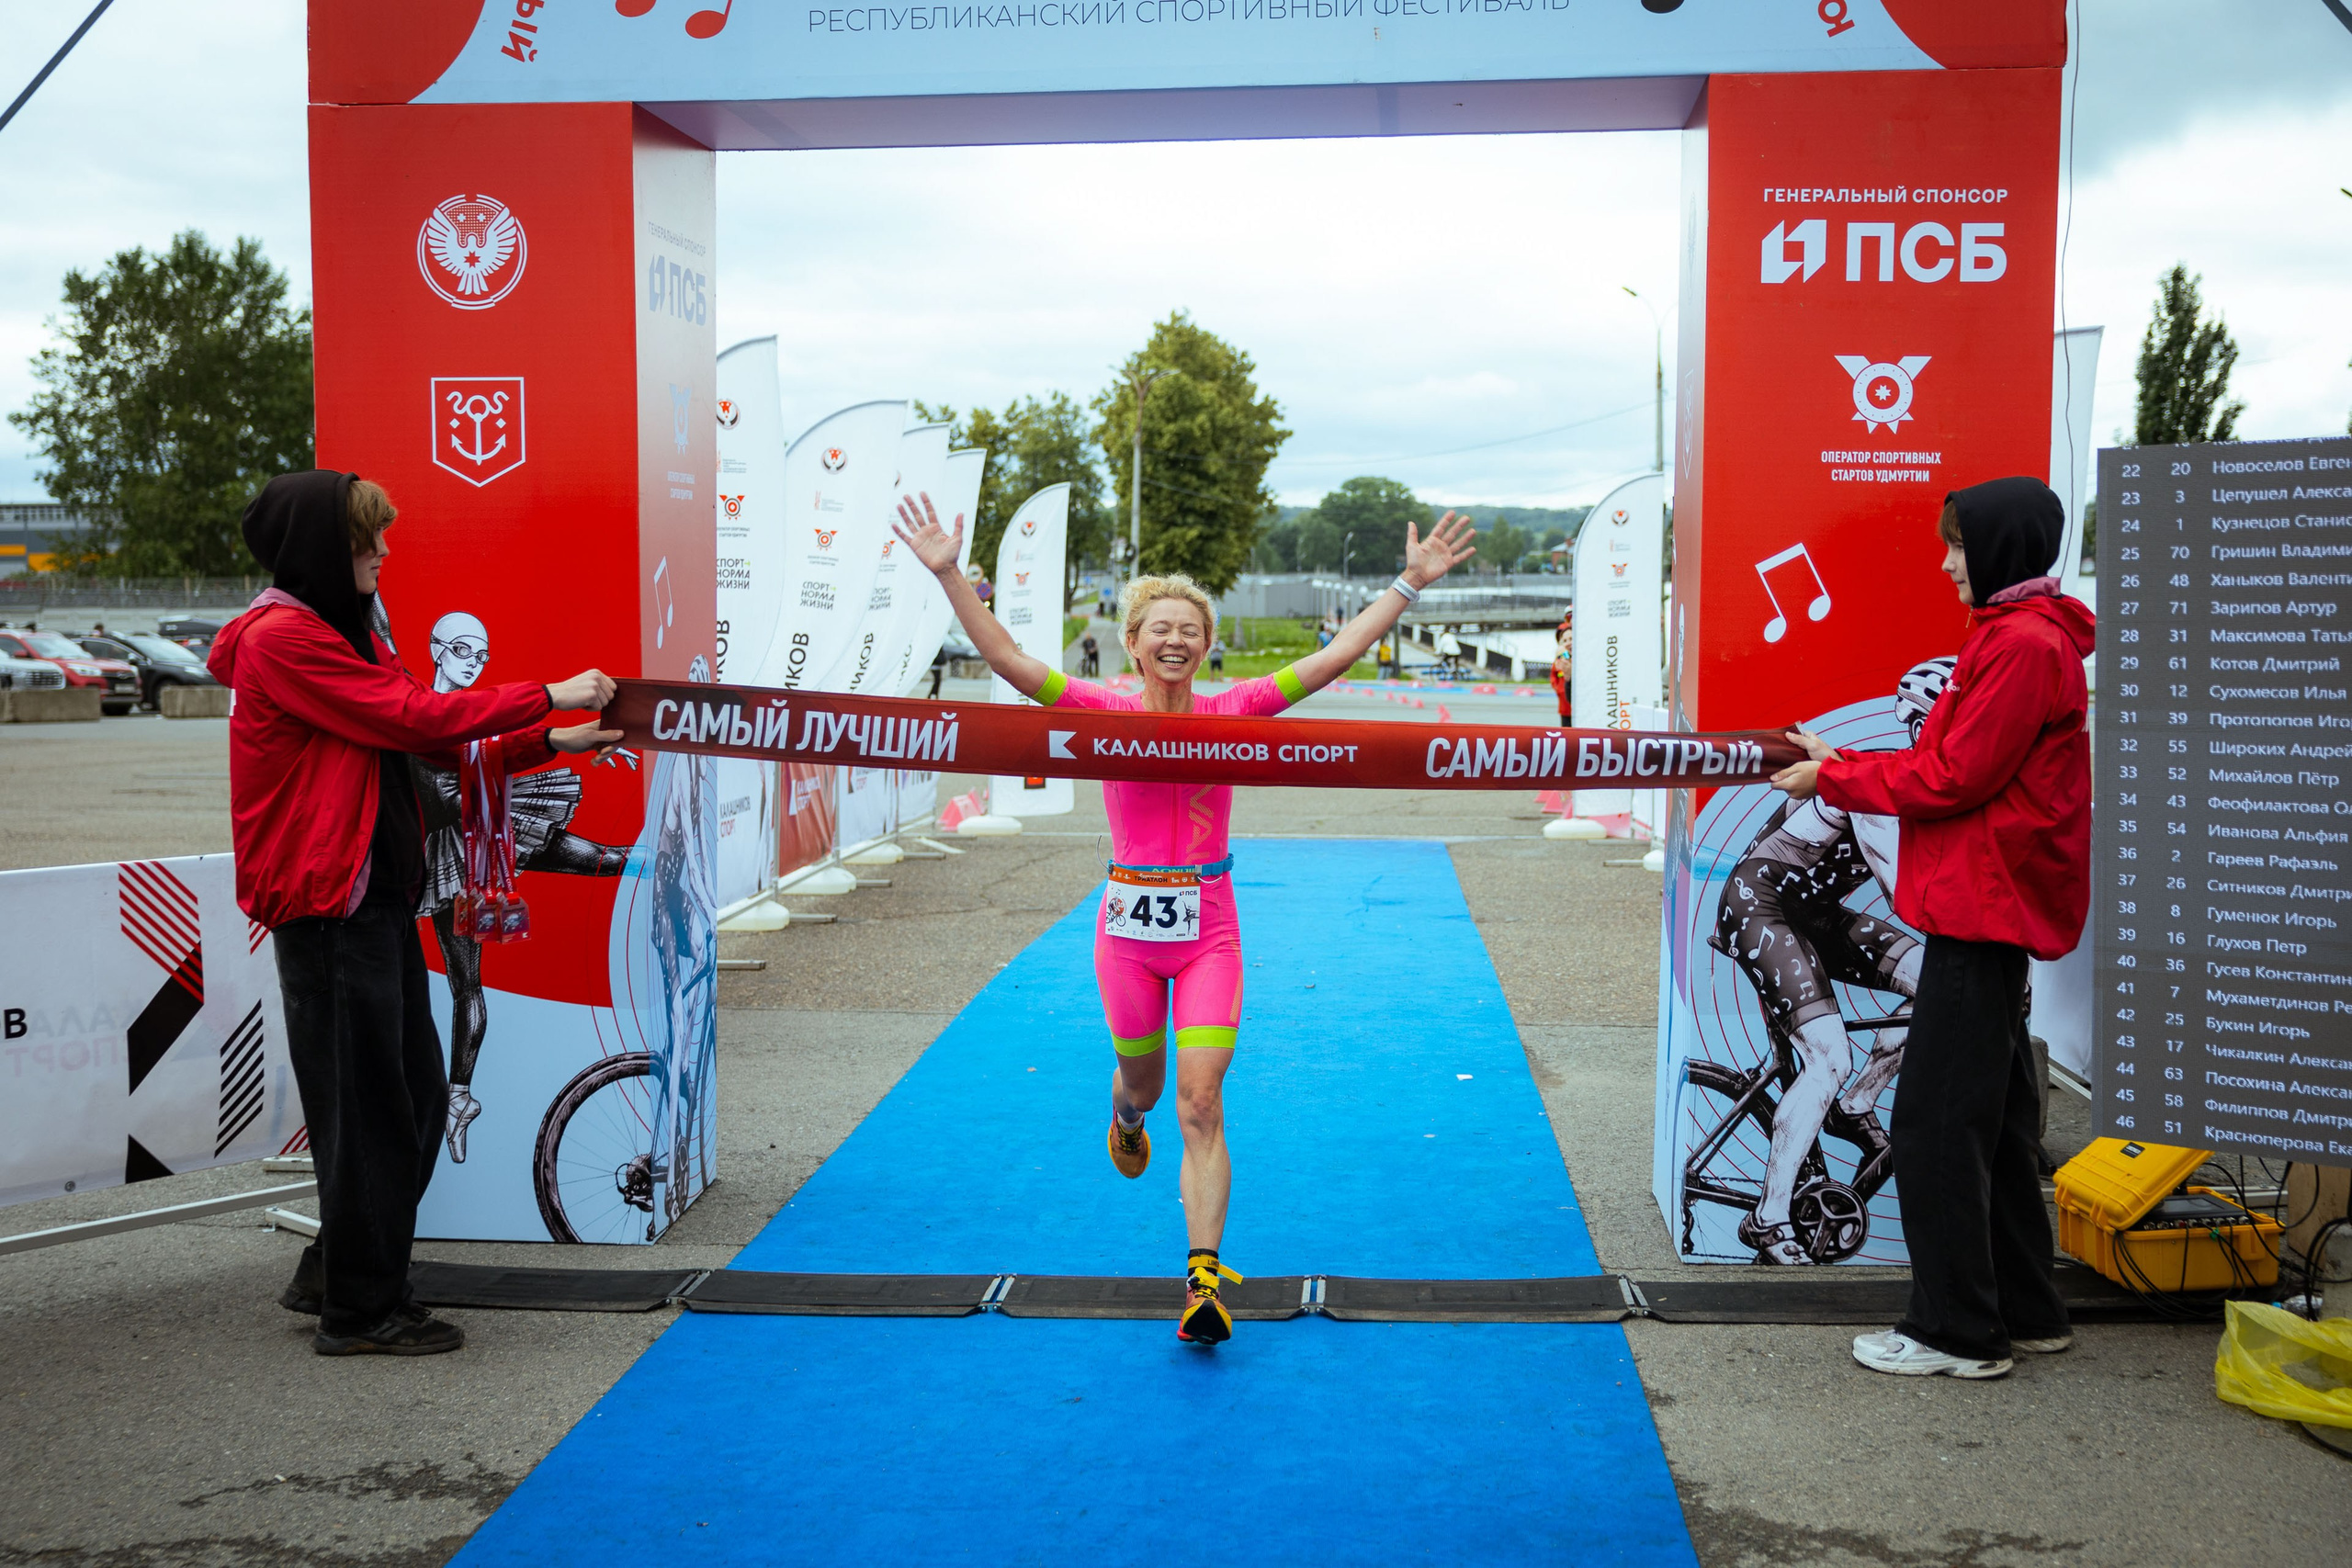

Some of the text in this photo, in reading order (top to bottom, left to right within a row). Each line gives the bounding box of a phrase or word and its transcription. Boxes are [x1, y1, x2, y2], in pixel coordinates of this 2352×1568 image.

[809, 0, 1125, 32] РЕСПУБЛИКАНСКИЙ
[1136, 0, 1363, 23] СПОРТИВНЫЙ
[1763, 186, 2008, 203] ГЕНЕРАЛЬНЫЙ СПОНСОР
[1846, 220, 2007, 283] ПСБ
[669, 261, 707, 326] ПСБ
[1821, 450, 1941, 465] ОПЕРАТОР СПОРТИВНЫХ
[2122, 464, 2142, 478] 22
[2171, 461, 2192, 476] 20
[2213, 459, 2306, 474] Новоселов
[1831, 468, 1929, 482] СТАРТОВ УДМУРТИИ
[2121, 491, 2142, 505] 23
[2176, 490, 2187, 503] 3
[2212, 489, 2290, 504] Цепушел
[2121, 519, 2142, 533] 24
[2177, 517, 2184, 531] 1
[2212, 516, 2291, 534] Кузнецов
[2120, 547, 2142, 560] 25
[2170, 546, 2191, 559] 70
[2211, 545, 2278, 561] Гришин
[802, 581, 831, 592] СПОРТ
[2121, 574, 2142, 588] 26
[2169, 573, 2191, 587] 48
[2211, 573, 2285, 587] Ханыков
[799, 599, 834, 611] ЖИЗНИ
[800, 590, 835, 602] НОРМА
[2120, 600, 2339, 617] 27 71 Зарипов Артур
[2120, 628, 2141, 643] 28
[2169, 628, 2188, 643] 31
[2211, 628, 2307, 643] Максимова
[2120, 656, 2341, 674] 29 61 Котов Дмитрий
[2120, 683, 2348, 702] 30 12 Сухомесов Илья
[652, 698, 960, 761] САМЫЙ ЛУЧШИЙ
[2120, 710, 2352, 729] 31 39 Протопопов Иго
[1092, 738, 1359, 762] КАЛАШНИКОВ СПОРТ
[1426, 731, 1763, 778] САМЫЙ БЫСТРЫЙ
[2120, 738, 2139, 752] 32
[2169, 739, 2188, 753] 55
[2210, 740, 2287, 758] Широких
[2120, 765, 2341, 789] 33 52 Михайлов Пётр
[2119, 792, 2352, 815] 34 43 Феофилактова О
[2119, 819, 2350, 845] 35 54 Иванова Альфия
[2119, 846, 2340, 873] 36 2 Гареев Рафаэль
[2118, 874, 2138, 886] 37
[2166, 876, 2188, 890] 26
[2208, 879, 2288, 897] Ситников
[1129, 895, 1179, 929] 43
[2119, 900, 2338, 931] 38 8 Гуменюк Игорь
[2118, 927, 2309, 957] 39 16 Глухов Петр
[2117, 954, 2352, 987] 40 36 Гусев Константин
[2117, 981, 2135, 995] 41
[2170, 986, 2182, 998] 7
[2206, 988, 2331, 1012] Мухаметдинов
[2117, 1008, 2312, 1041] 42 25 Букин Игорь
[2117, 1034, 2136, 1048] 43
[2165, 1039, 2186, 1053] 17
[2206, 1043, 2286, 1064] Чикалкин
[2116, 1061, 2136, 1076] 44
[2165, 1066, 2185, 1081] 63
[2206, 1070, 2286, 1093] Посохина
[2116, 1088, 2136, 1102] 45
[2165, 1093, 2186, 1108] 58
[2204, 1098, 2290, 1121] Филиппов
[2116, 1114, 2137, 1129] 46
[2165, 1120, 2183, 1134] 51
[2204, 1125, 2325, 1153] Красноперова
